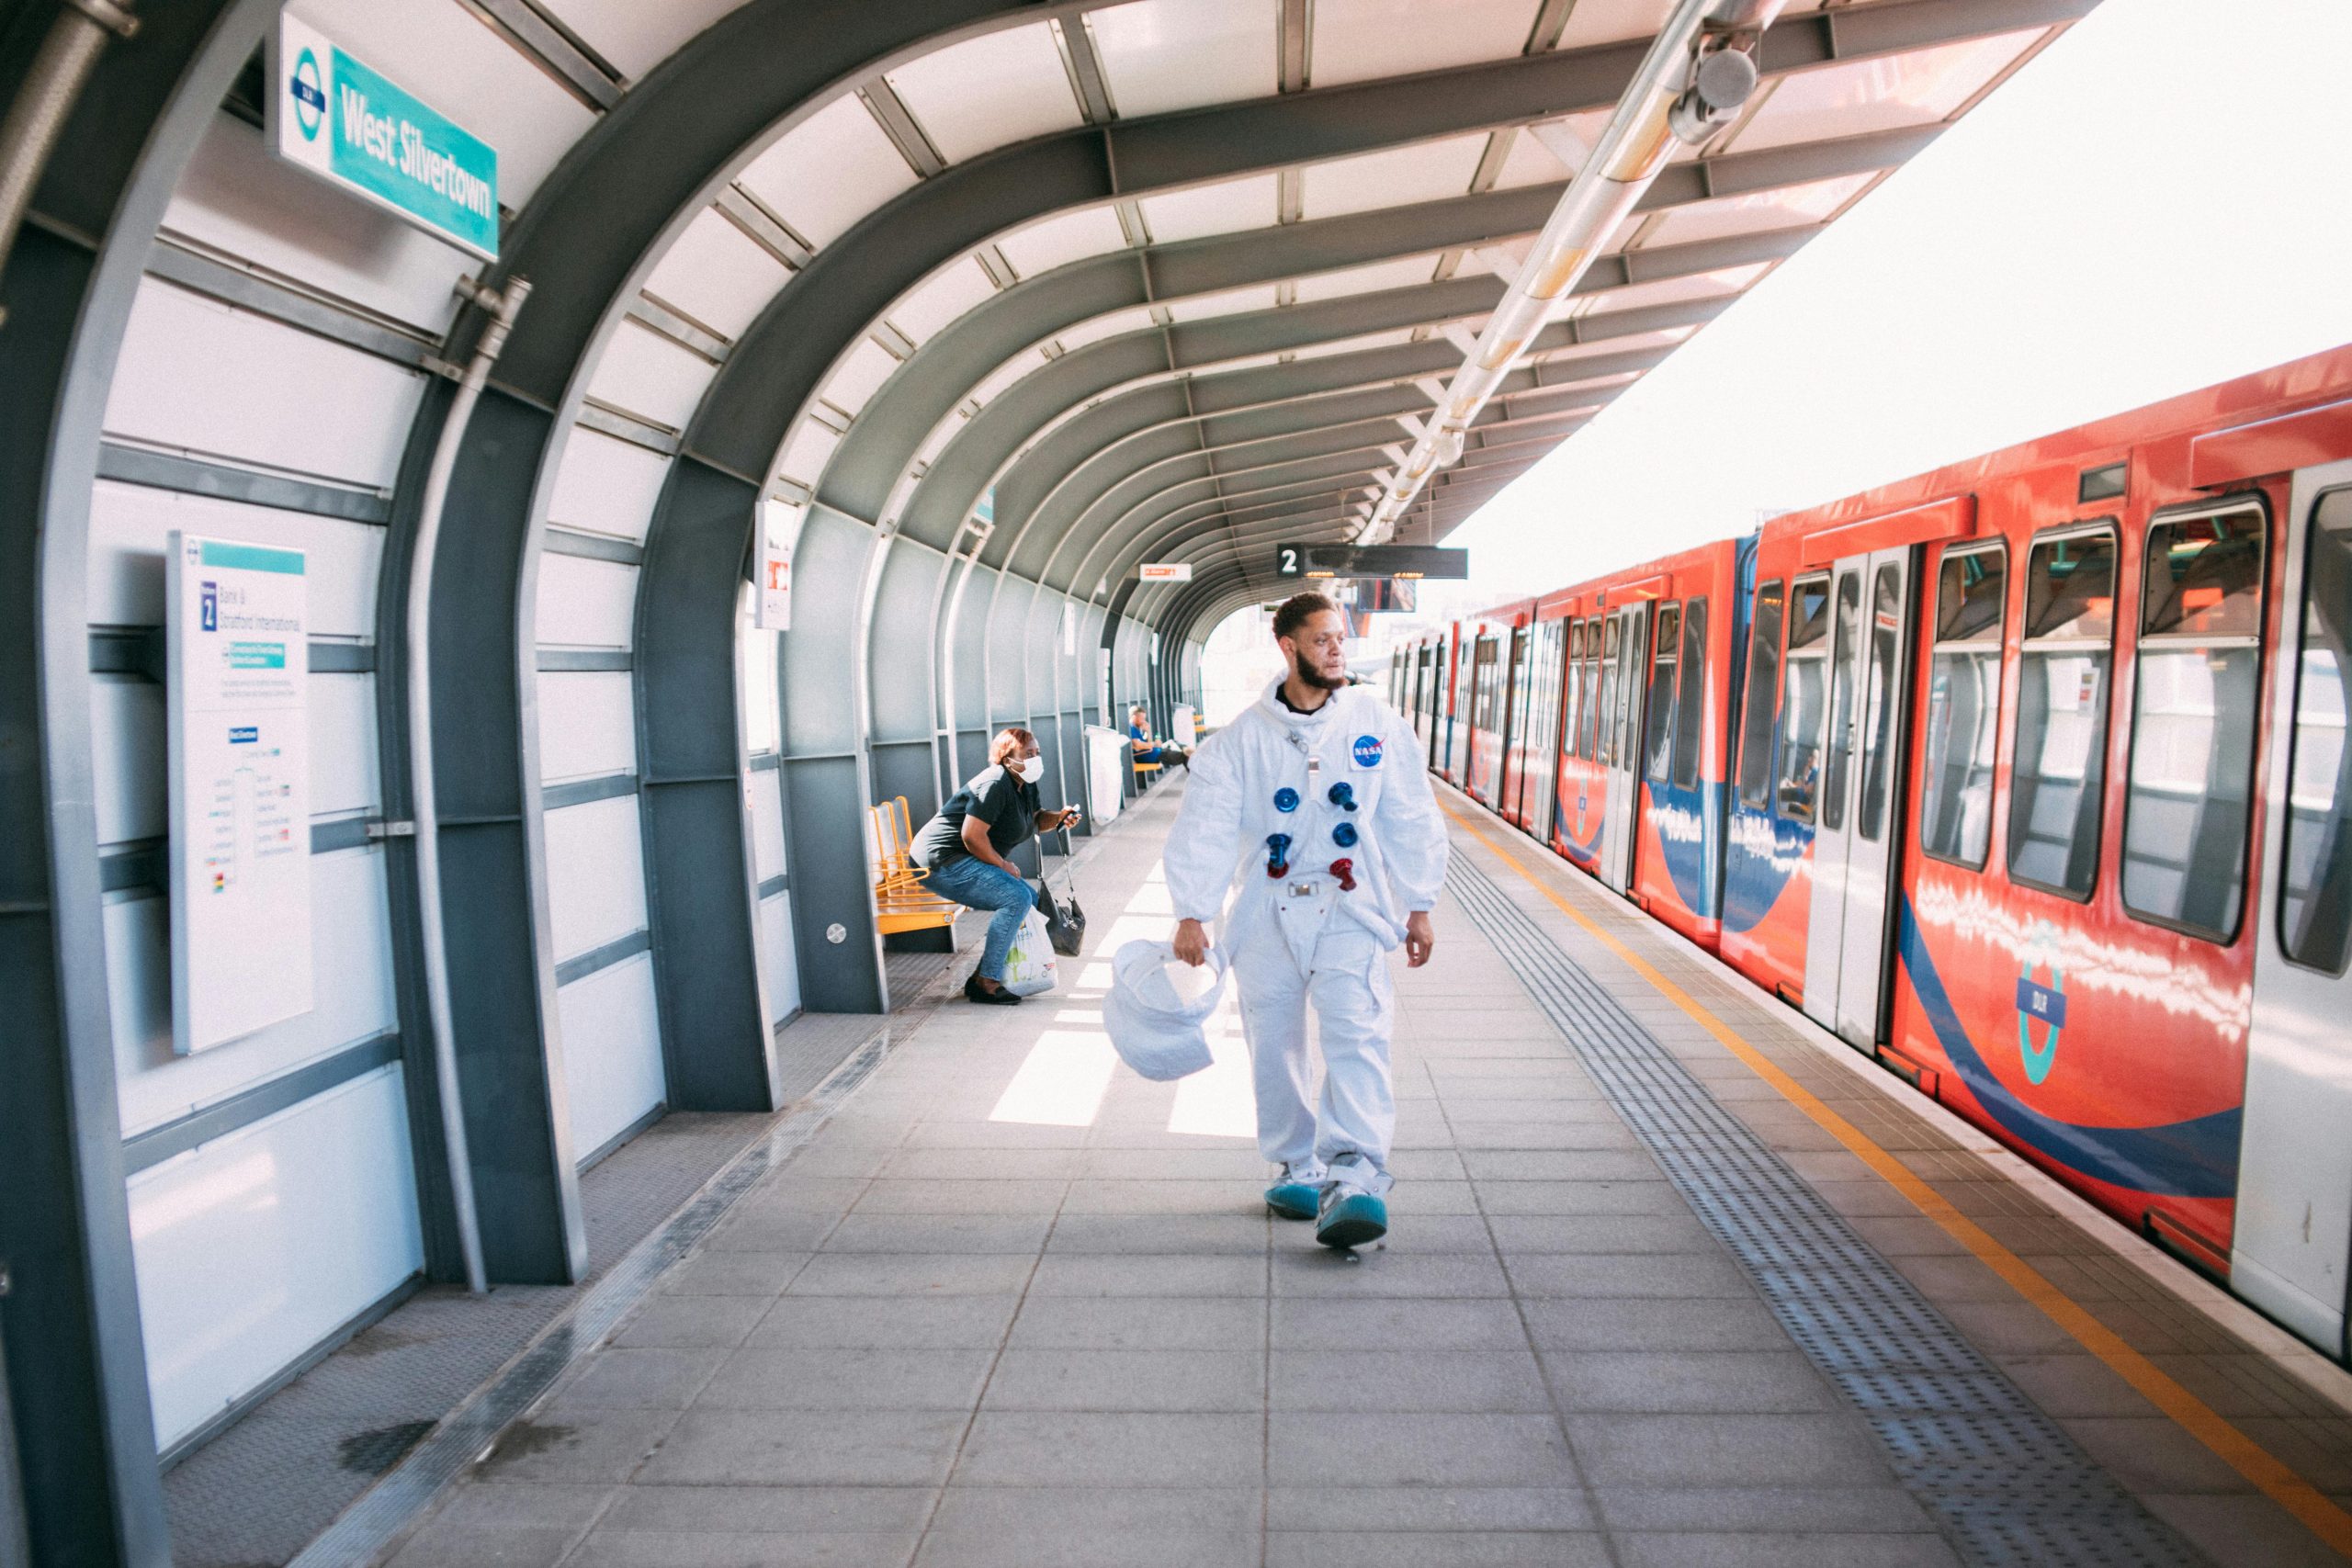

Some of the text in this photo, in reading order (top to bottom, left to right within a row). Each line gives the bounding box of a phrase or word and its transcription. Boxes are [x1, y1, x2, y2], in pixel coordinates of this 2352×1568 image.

[341, 82, 492, 220] West Silvertown
[1282, 549, 1297, 573] 2
[204, 598, 213, 626] 2
[1354, 747, 1383, 756] NASA
[2032, 989, 2048, 1014] DLR
